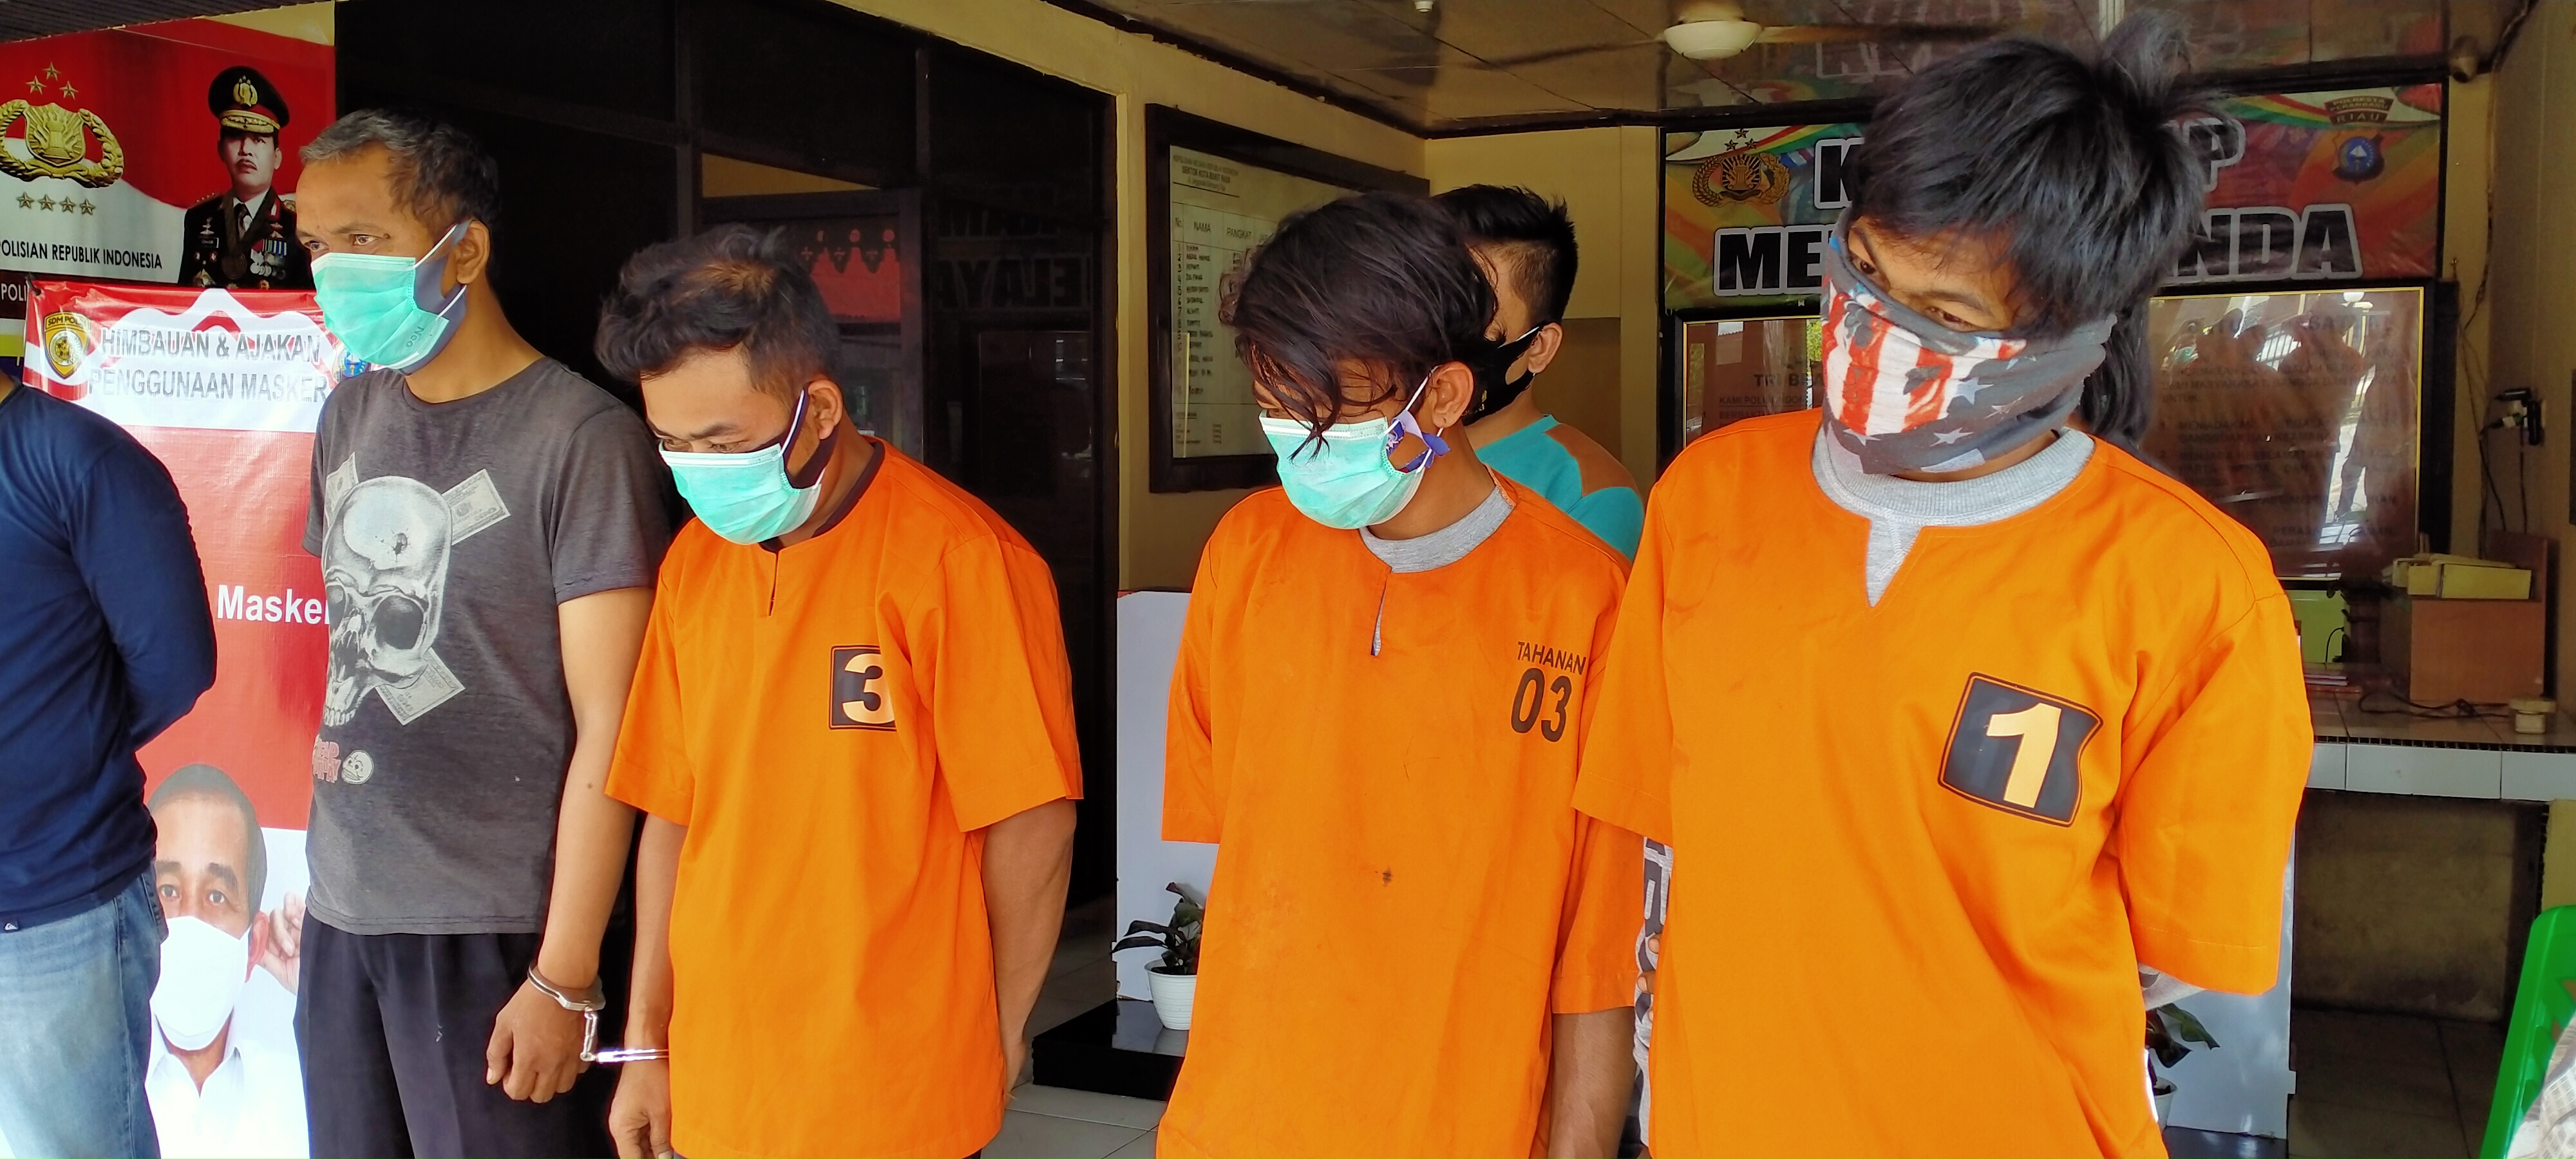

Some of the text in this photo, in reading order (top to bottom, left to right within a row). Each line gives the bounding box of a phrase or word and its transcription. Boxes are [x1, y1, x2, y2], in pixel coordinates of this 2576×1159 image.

[2336, 113, 2380, 123] RIAU
[1194, 221, 1211, 233] NAMA
[1227, 227, 1252, 239] PANGKAT
[0, 239, 163, 270] OLISIAN REPUBLIK INDONESIA
[1714, 203, 2363, 296] ME NDA
[48, 316, 63, 326] SDM
[100, 328, 320, 363] HIMBAUAN & AJAKAN
[88, 368, 327, 403] PENGGUNAAN MASKER
[1517, 641, 1586, 675] TAHANAN
[842, 653, 895, 724] 3
[1511, 667, 1572, 742] 03
[1985, 702, 2061, 808] 1
